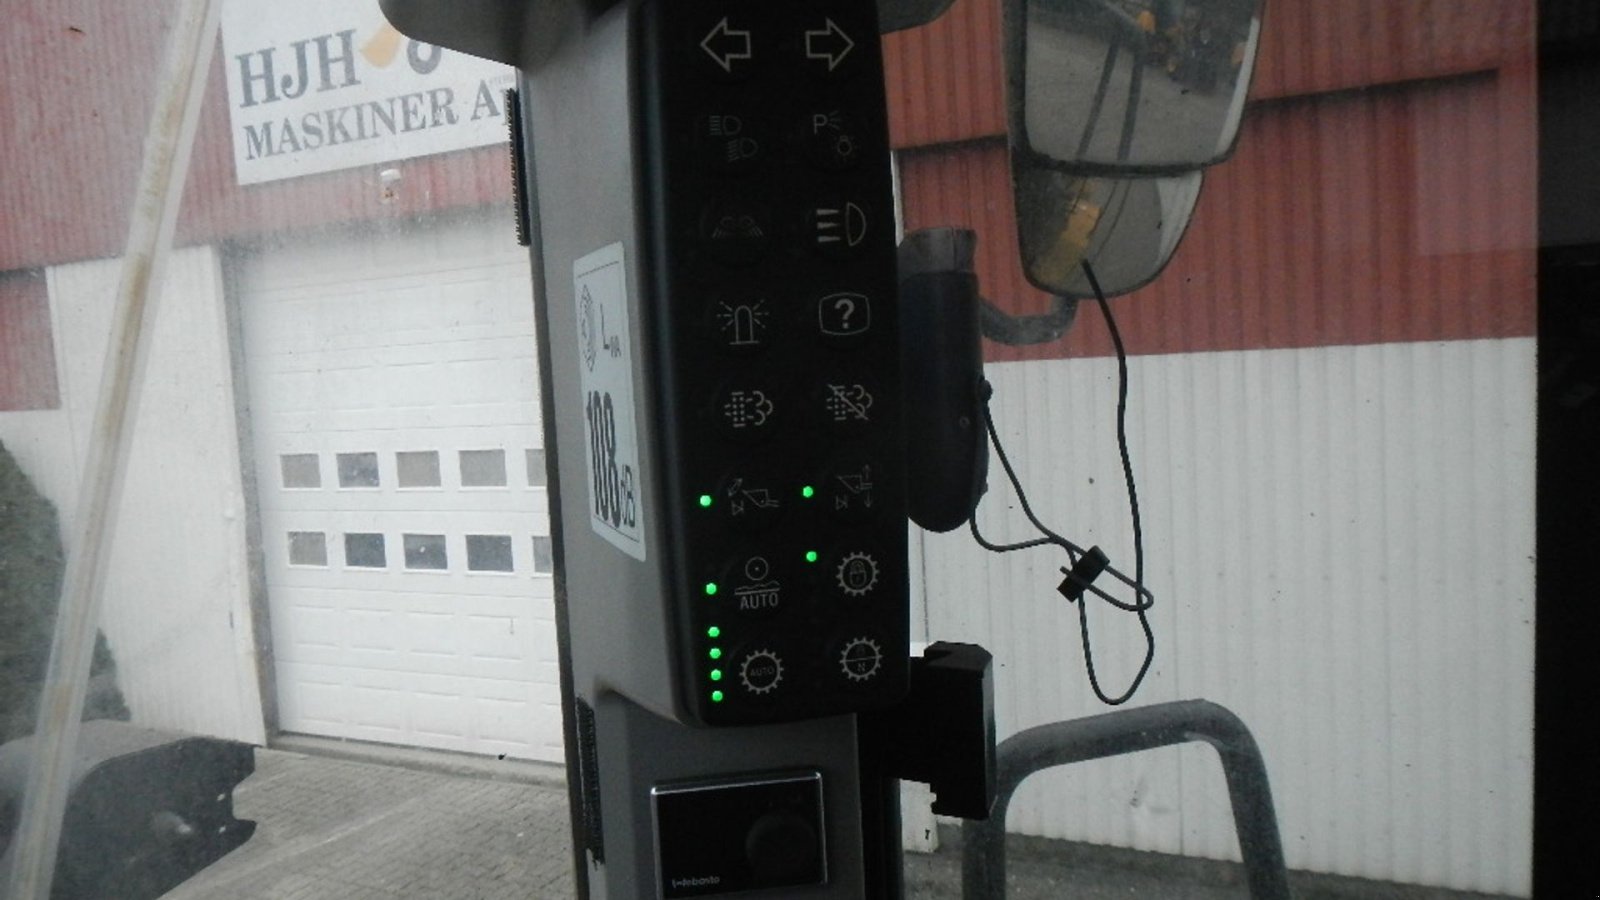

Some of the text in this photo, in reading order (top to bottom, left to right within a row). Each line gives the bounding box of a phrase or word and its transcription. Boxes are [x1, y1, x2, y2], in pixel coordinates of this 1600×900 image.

[235, 29, 361, 108] HJH
[244, 86, 460, 160] MASKINER
[586, 390, 620, 528] 108
[739, 592, 779, 610] AUTO
[750, 665, 776, 677] AUTO
